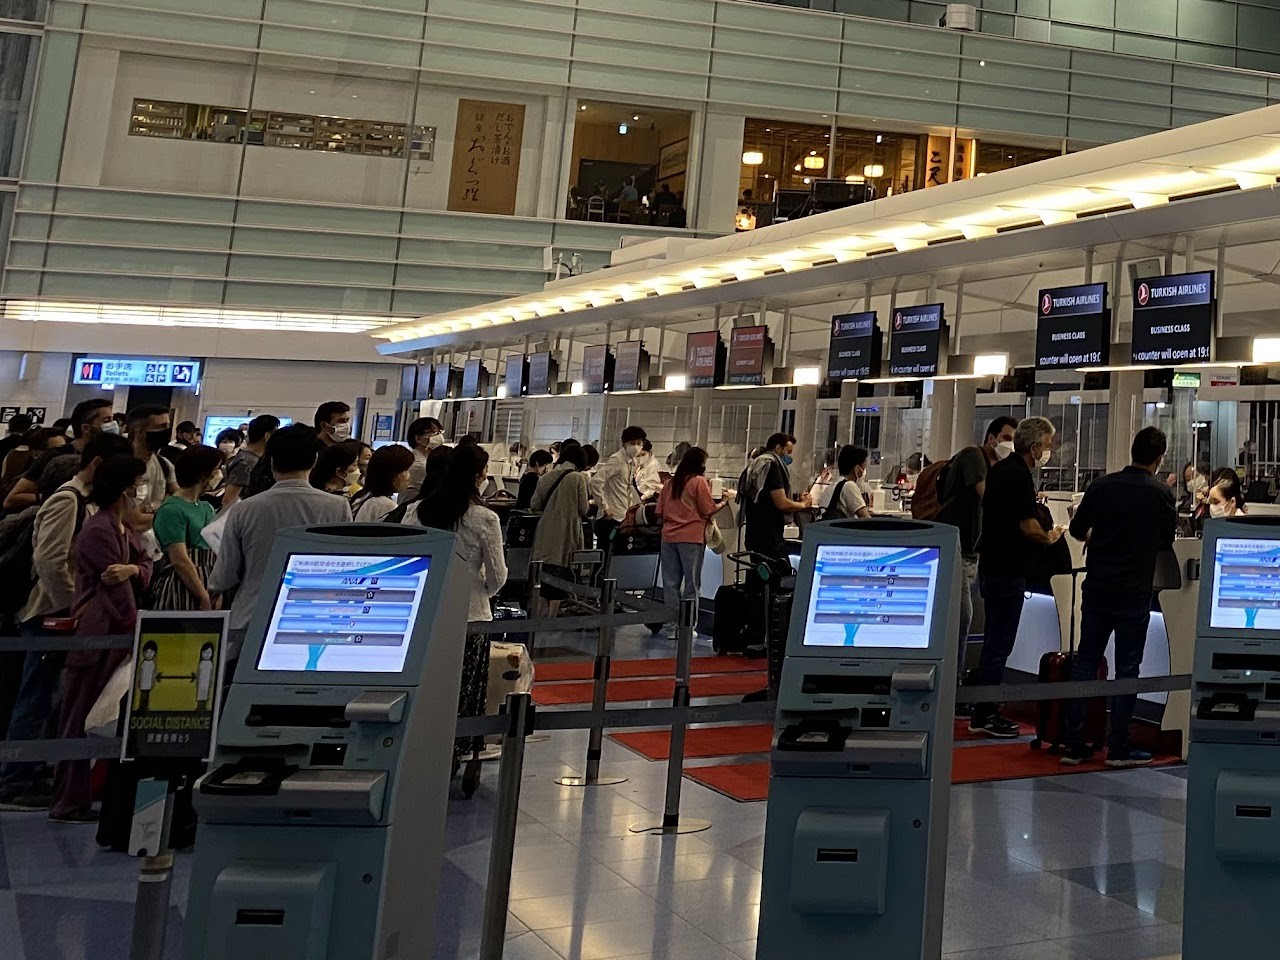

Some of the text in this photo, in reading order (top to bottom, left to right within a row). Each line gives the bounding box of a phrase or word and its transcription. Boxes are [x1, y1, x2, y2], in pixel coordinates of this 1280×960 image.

[1151, 283, 1206, 298] TURKISH AIRLINES
[1053, 294, 1100, 308] TURKISH AIRLINES
[1150, 324, 1191, 334] BUSINESS CLASS
[1040, 355, 1059, 365] counter
[1069, 354, 1082, 364] open
[1138, 350, 1160, 360] counter
[1161, 348, 1172, 359] will
[1172, 349, 1189, 359] open
[1189, 347, 1196, 358] at
[131, 716, 210, 730] SOCIAL DISTANCE
